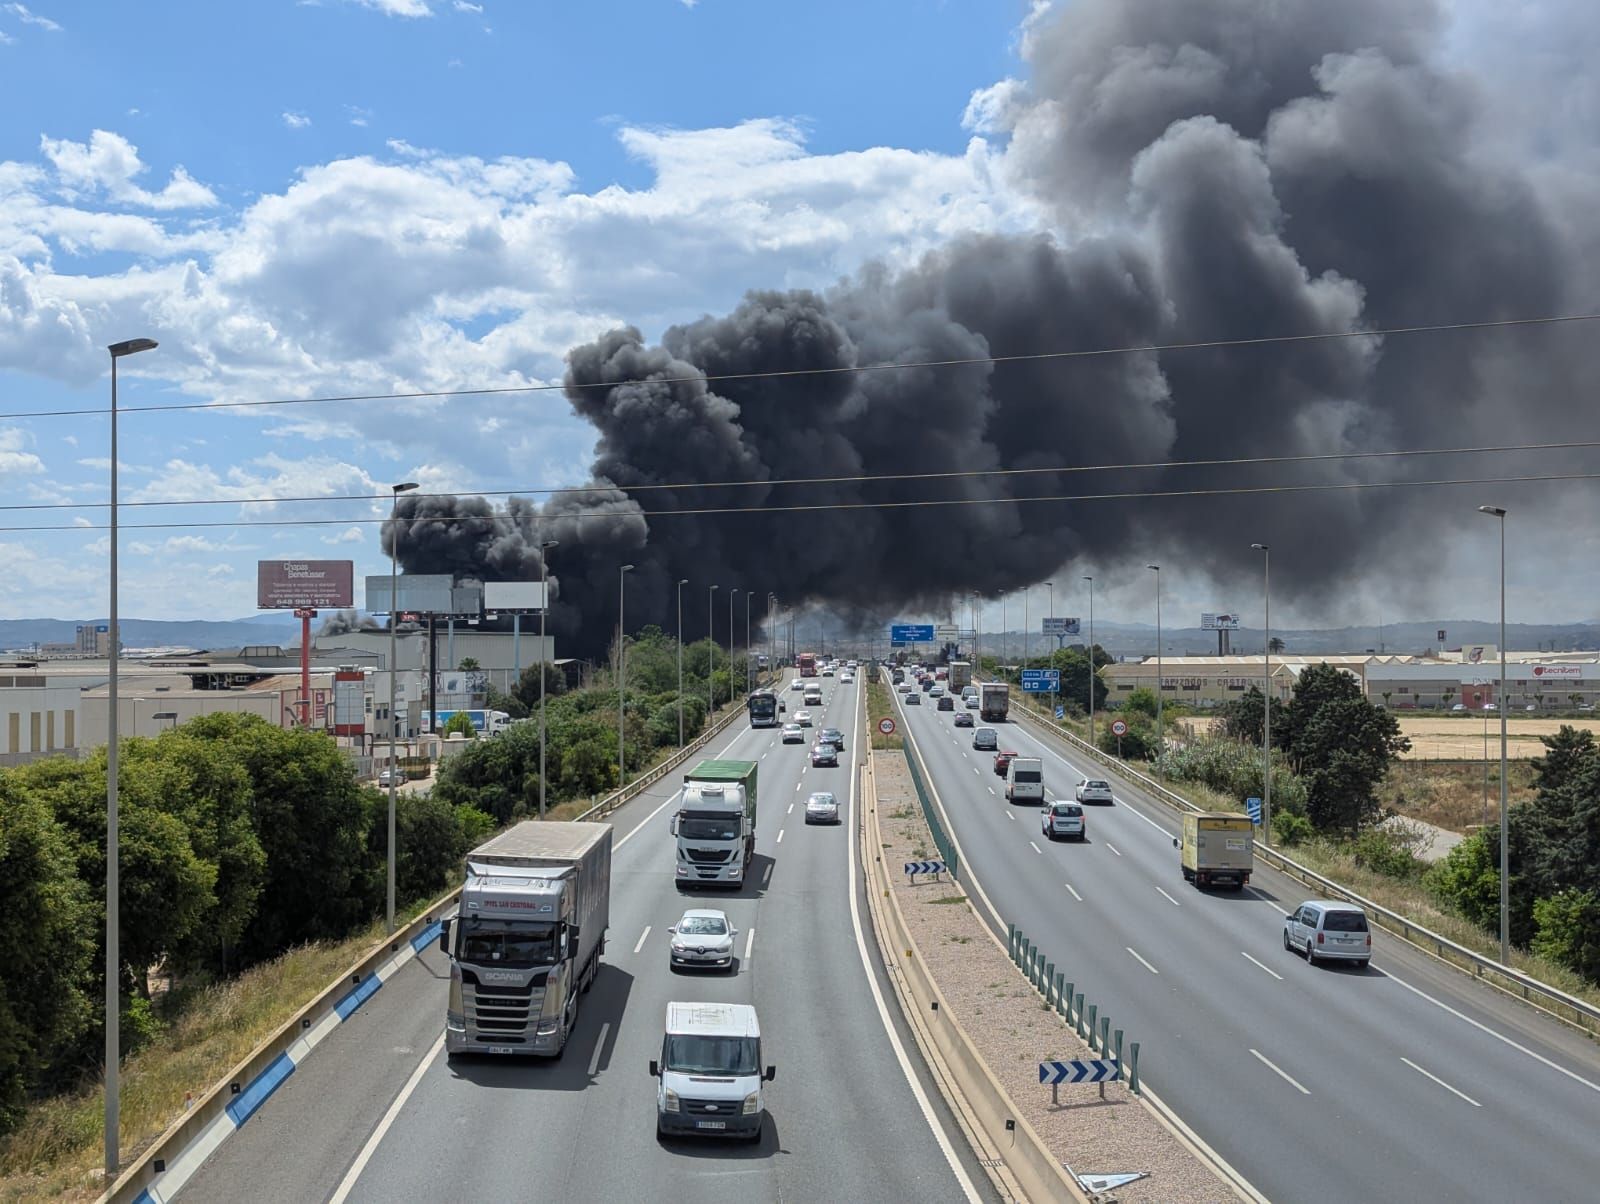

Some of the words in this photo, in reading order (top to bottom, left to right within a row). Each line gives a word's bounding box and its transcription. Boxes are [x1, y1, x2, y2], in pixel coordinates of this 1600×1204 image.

[1544, 666, 1581, 674] tecnitem
[1160, 678, 1208, 687] TAPIZADOS
[1217, 678, 1253, 687] CASTRO
[485, 973, 524, 982] SCANIA
